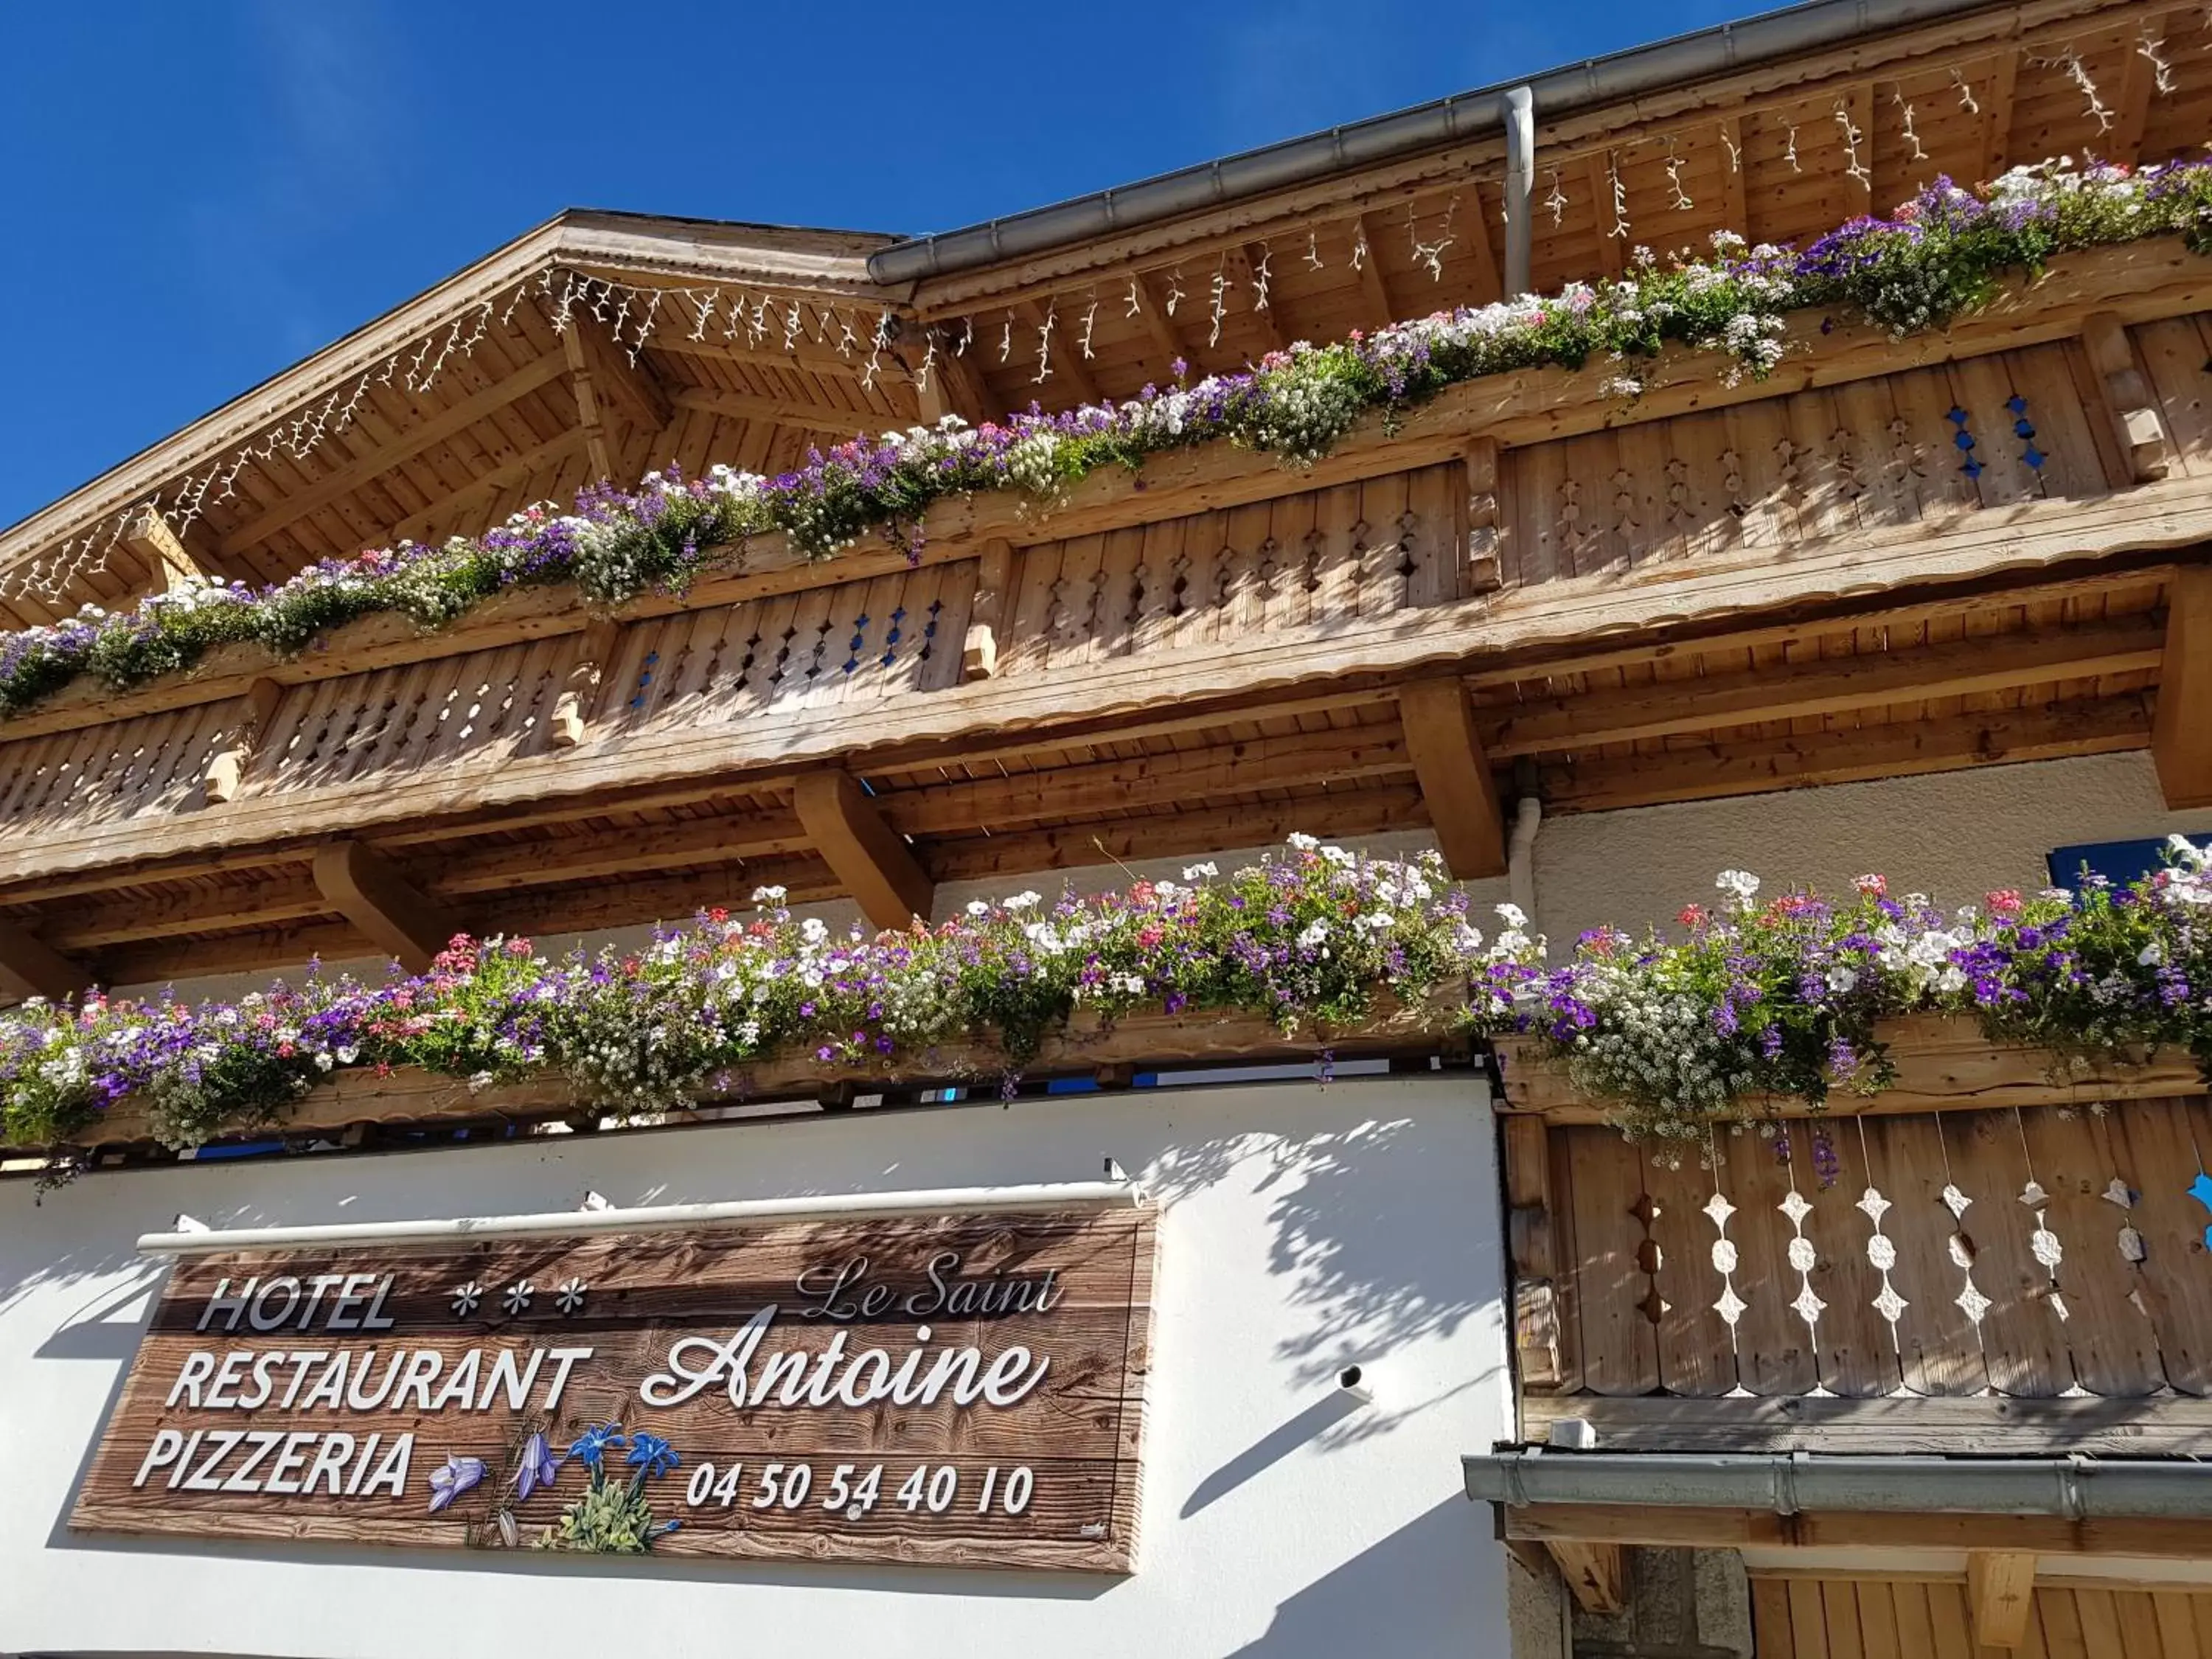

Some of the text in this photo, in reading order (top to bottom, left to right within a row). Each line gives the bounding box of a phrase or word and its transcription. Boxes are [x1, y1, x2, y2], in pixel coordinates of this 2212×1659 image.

[196, 1273, 395, 1331] HOTEL
[796, 1253, 1065, 1319] Le Saint
[165, 1348, 594, 1410] RESTAURANT
[639, 1304, 1050, 1408] Antoine
[132, 1430, 414, 1496] PIZZERIA
[686, 1463, 1034, 1514] 04 50 54 40 10
